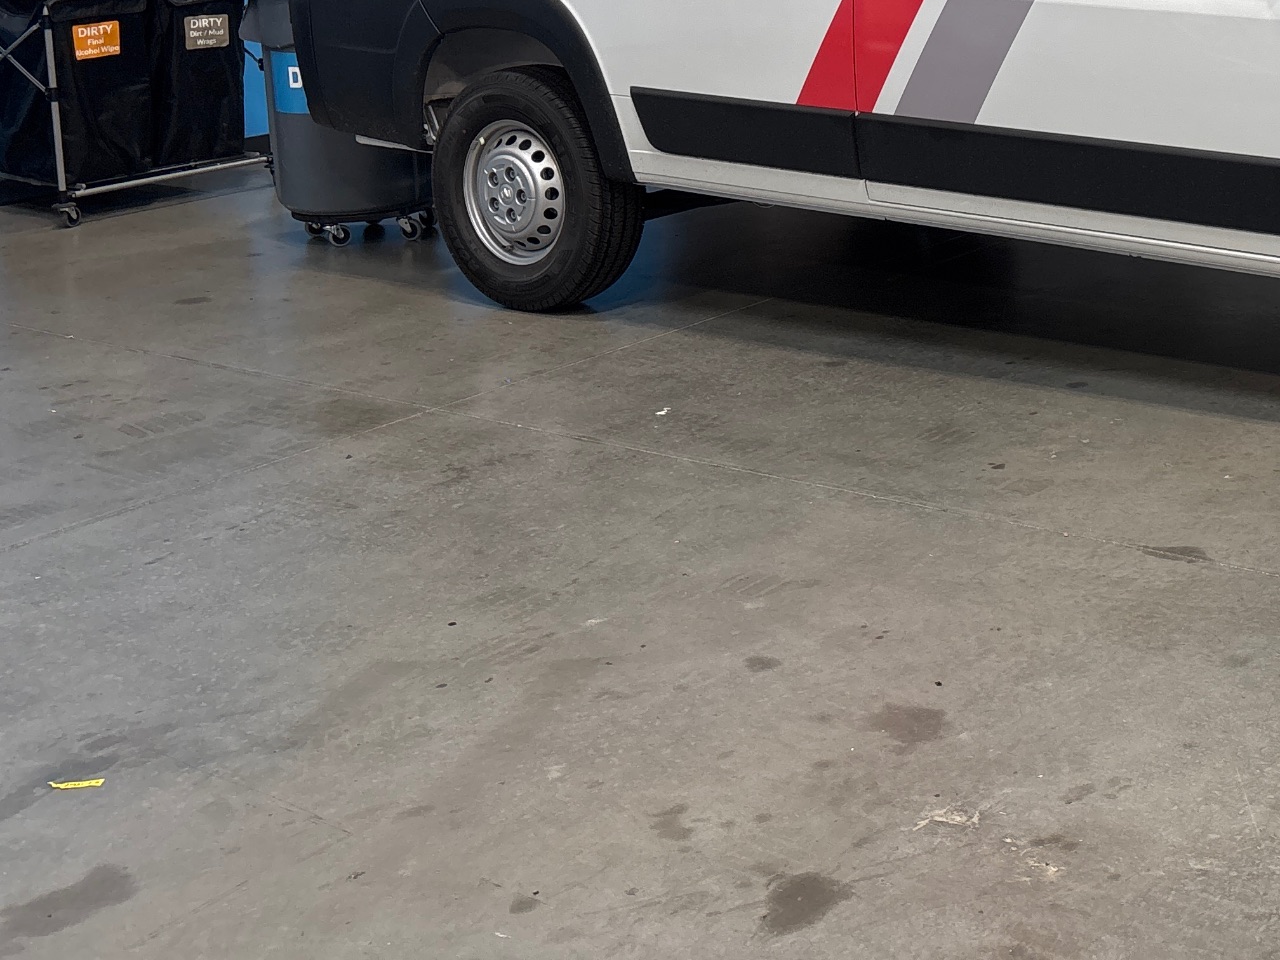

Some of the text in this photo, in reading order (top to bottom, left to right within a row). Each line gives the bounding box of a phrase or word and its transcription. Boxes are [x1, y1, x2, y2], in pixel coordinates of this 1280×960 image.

[190, 17, 223, 29] DIRTY
[78, 24, 113, 38] DIRTY
[87, 37, 105, 46] Final
